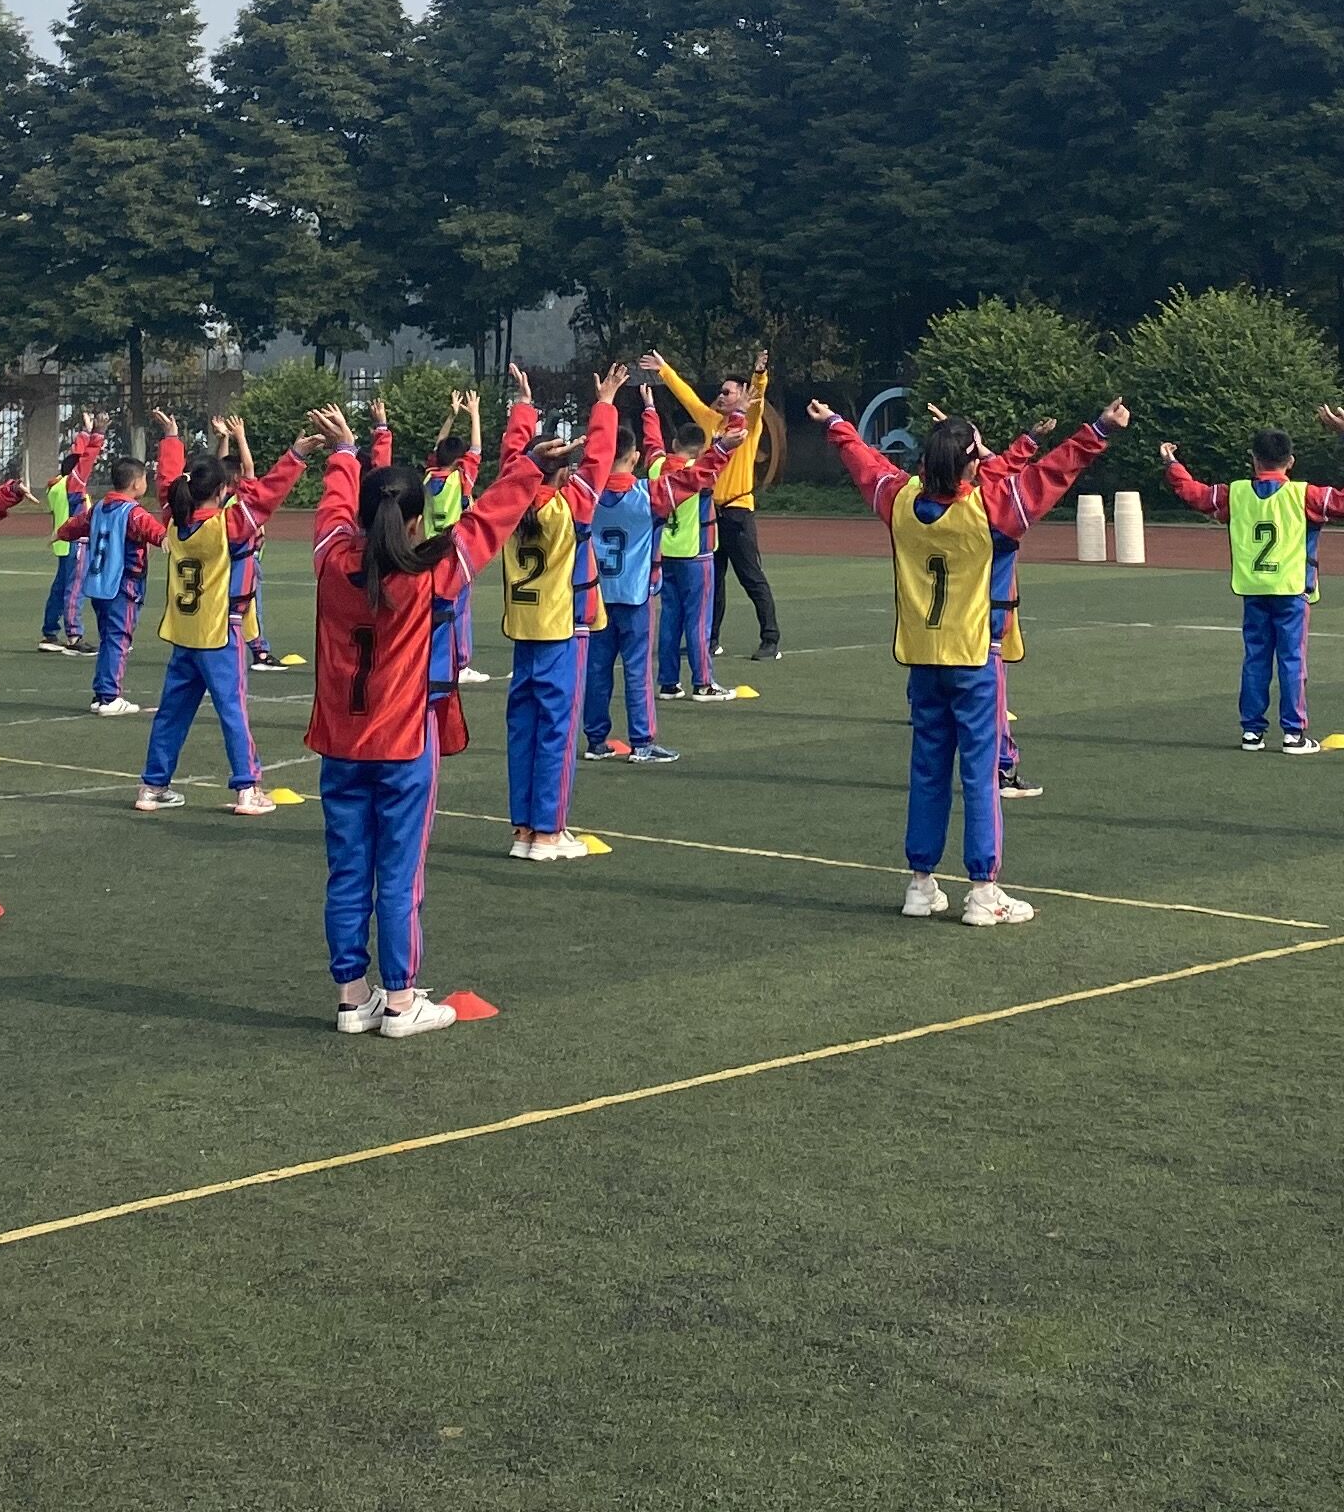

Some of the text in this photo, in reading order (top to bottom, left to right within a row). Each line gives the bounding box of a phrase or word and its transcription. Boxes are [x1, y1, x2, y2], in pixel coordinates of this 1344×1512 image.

[510, 544, 548, 606] 2
[598, 526, 628, 579] 3
[1252, 520, 1279, 574] 2
[176, 558, 205, 616] 3
[926, 554, 949, 630] 1
[349, 624, 377, 716] 1
